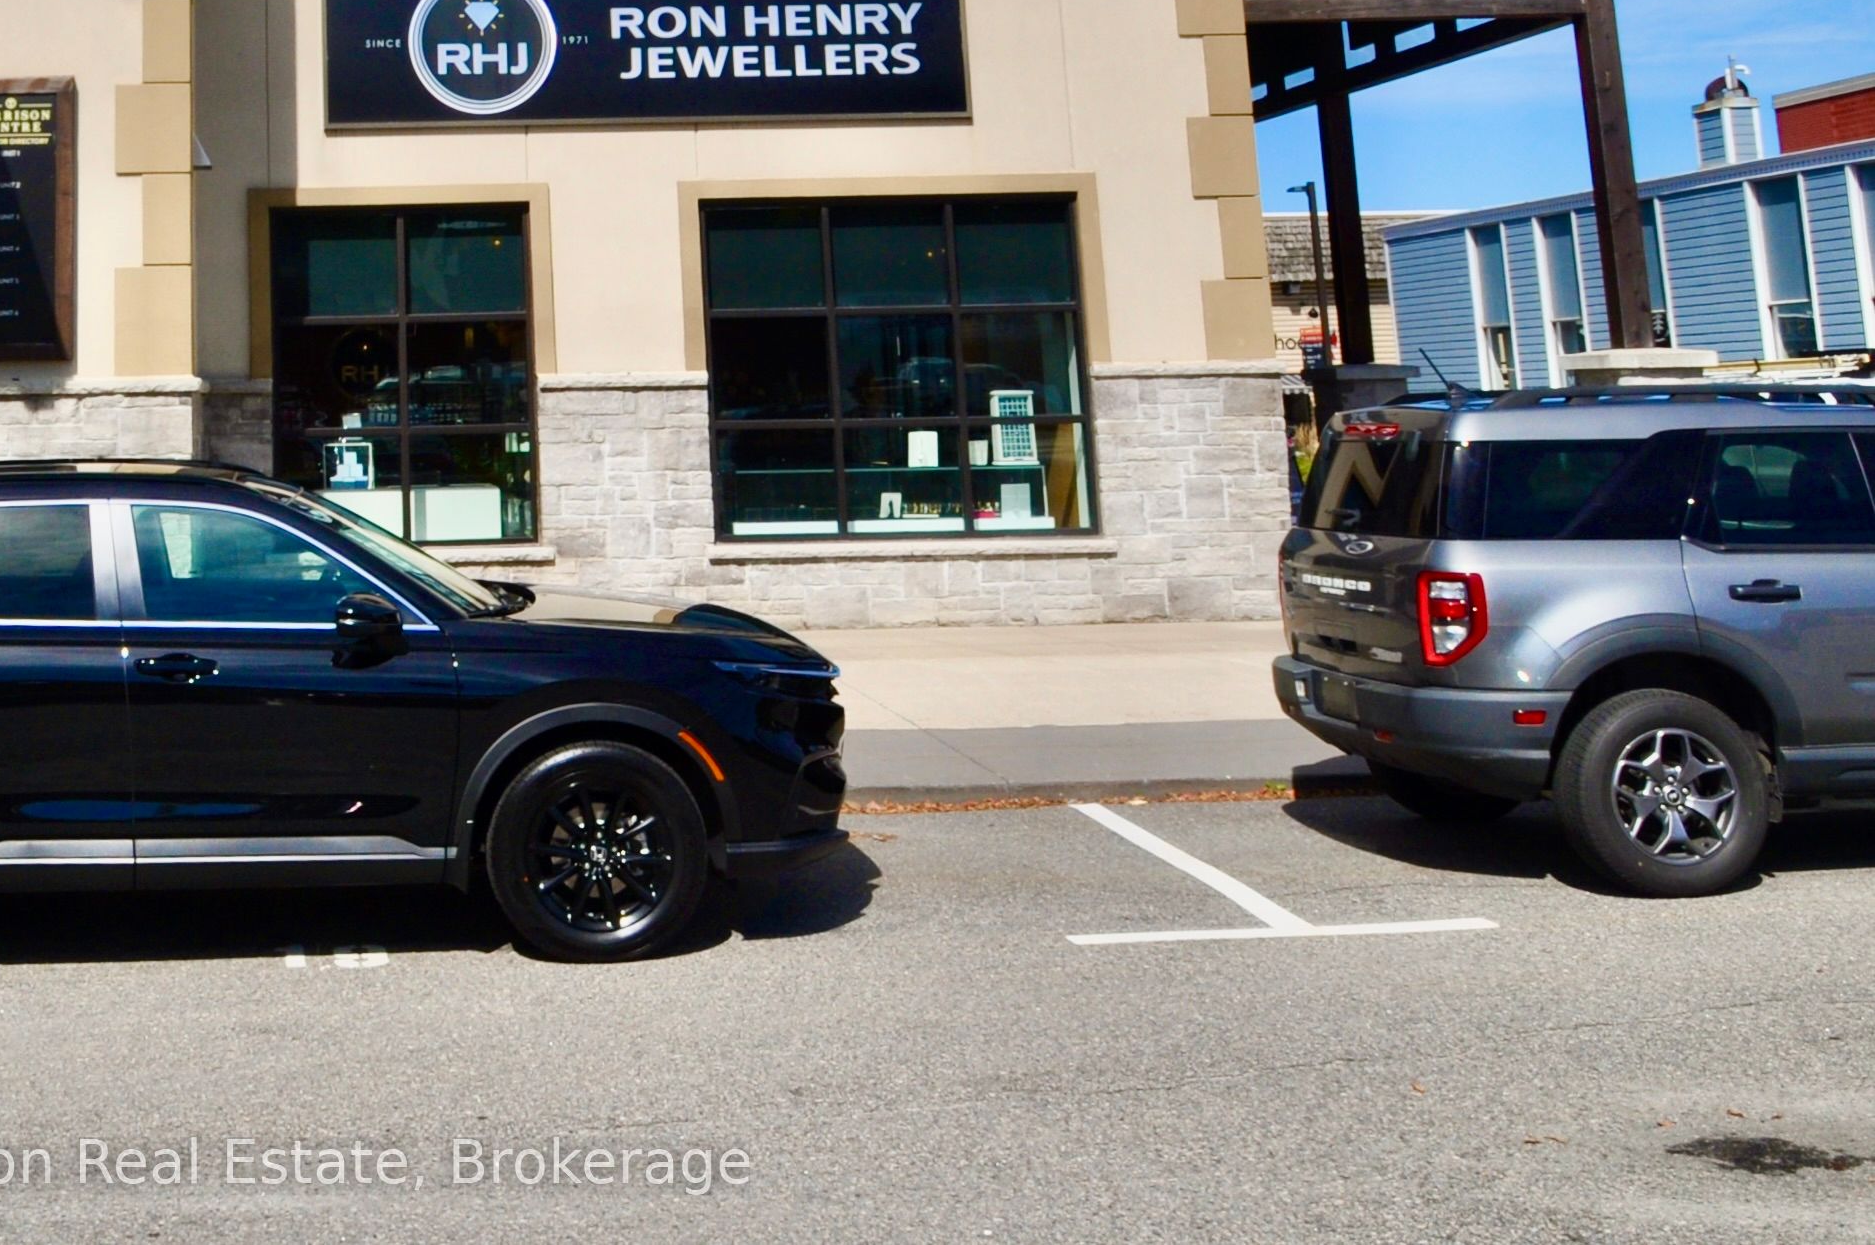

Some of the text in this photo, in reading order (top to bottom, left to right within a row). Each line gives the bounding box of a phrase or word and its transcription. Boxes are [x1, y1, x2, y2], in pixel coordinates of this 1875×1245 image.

[608, 1, 923, 40] RON HENRY
[365, 35, 589, 49] SINCE 1971
[436, 41, 529, 76] RHJ
[618, 41, 922, 81] JEWELLERS
